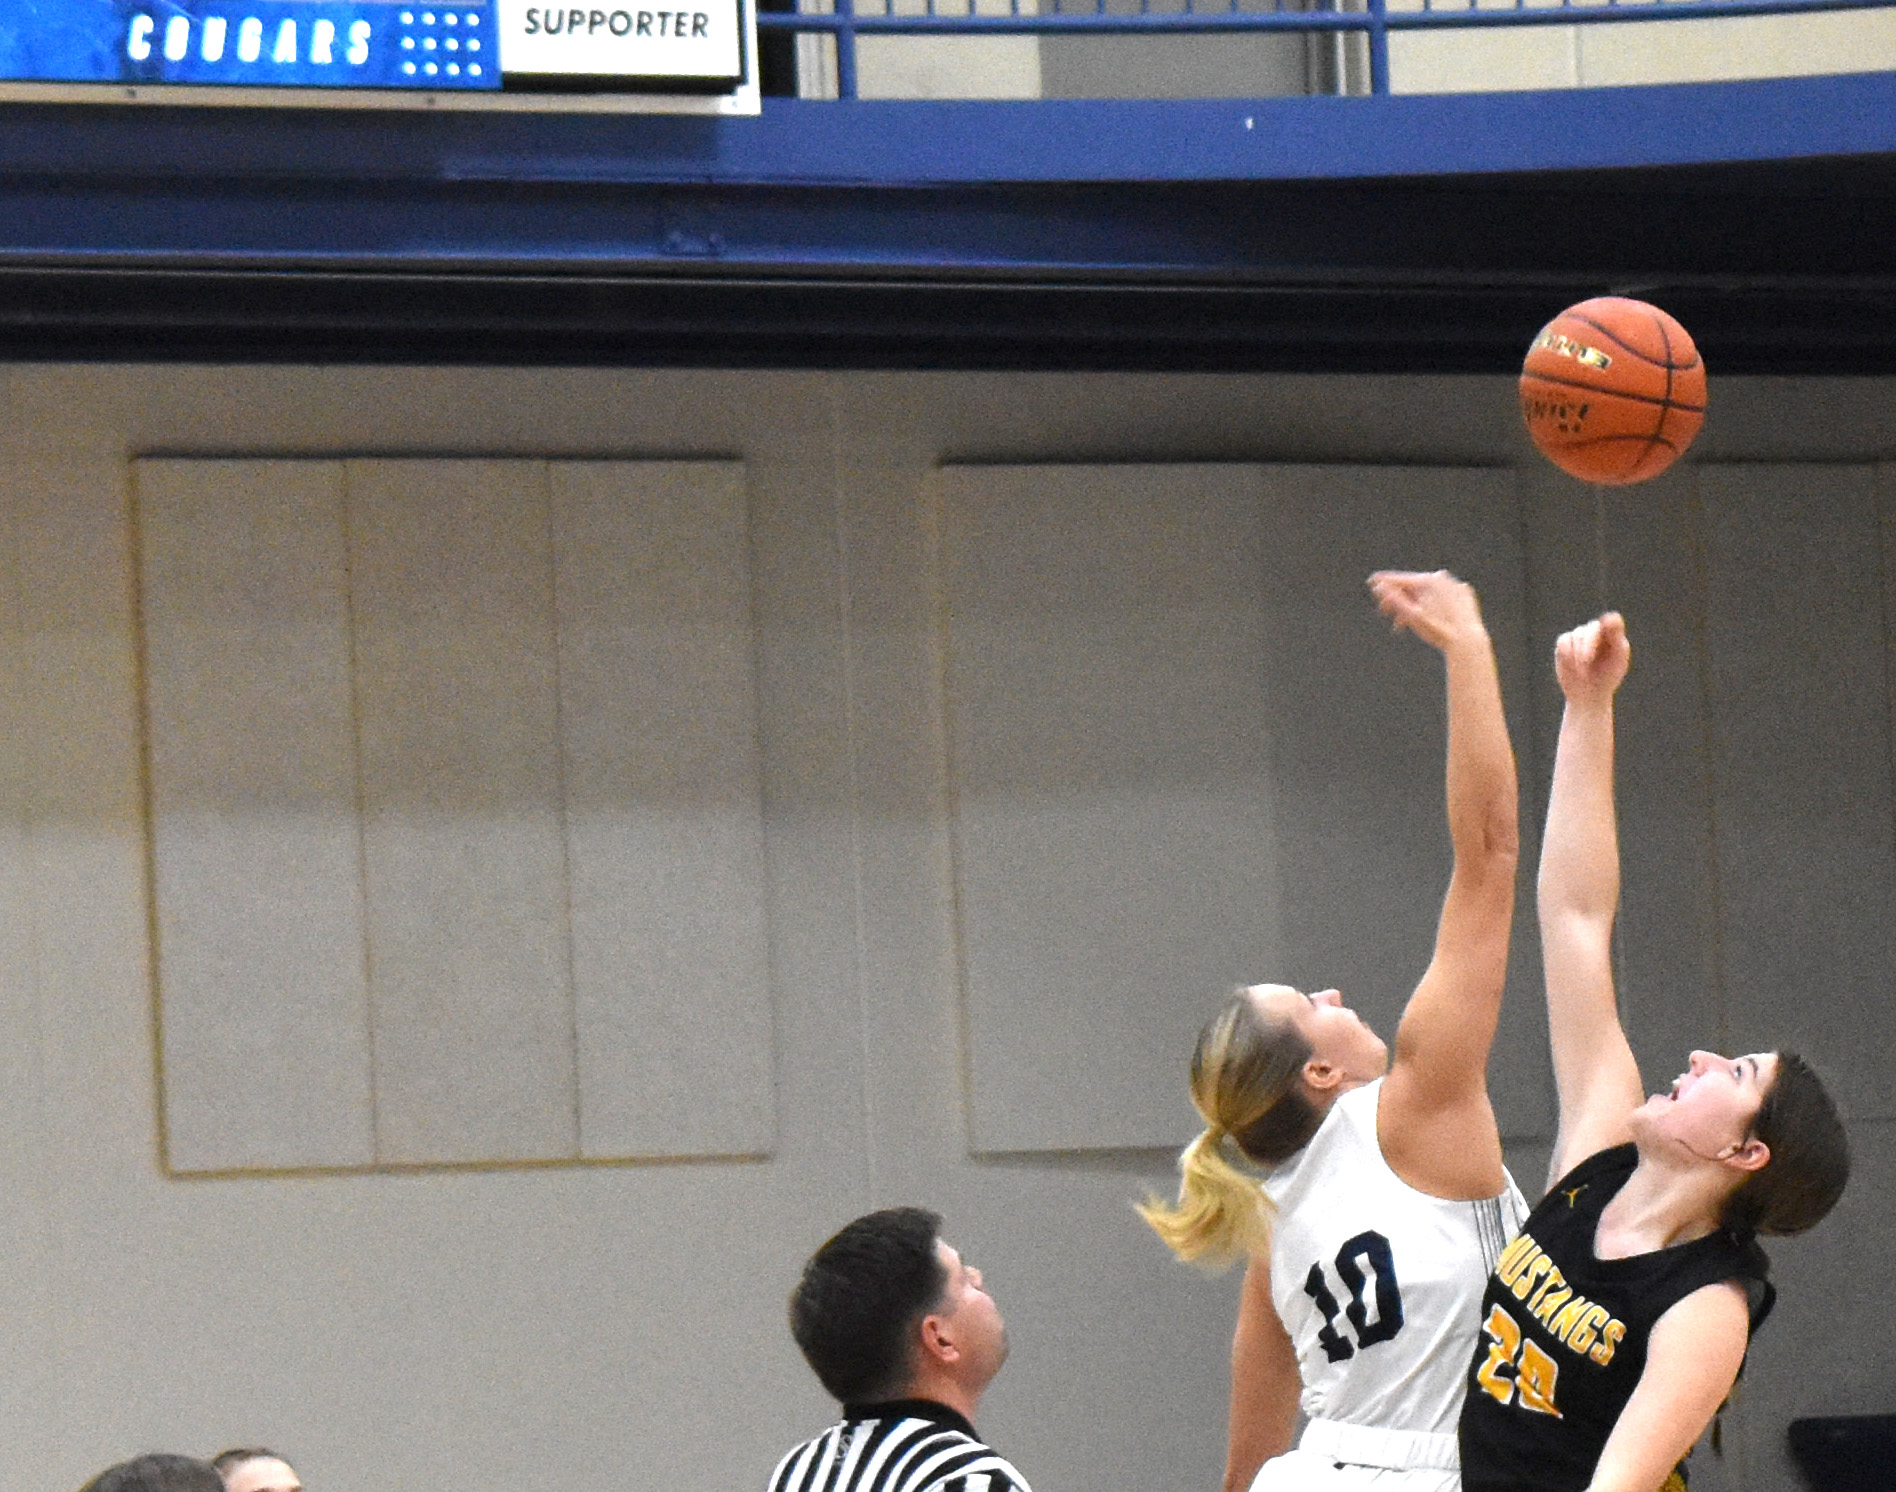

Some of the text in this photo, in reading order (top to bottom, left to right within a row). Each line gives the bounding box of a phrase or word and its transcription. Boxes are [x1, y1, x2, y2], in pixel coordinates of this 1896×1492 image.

[127, 14, 371, 65] COUGARS
[524, 8, 709, 38] SUPPORTER
[1304, 1230, 1404, 1363] 10
